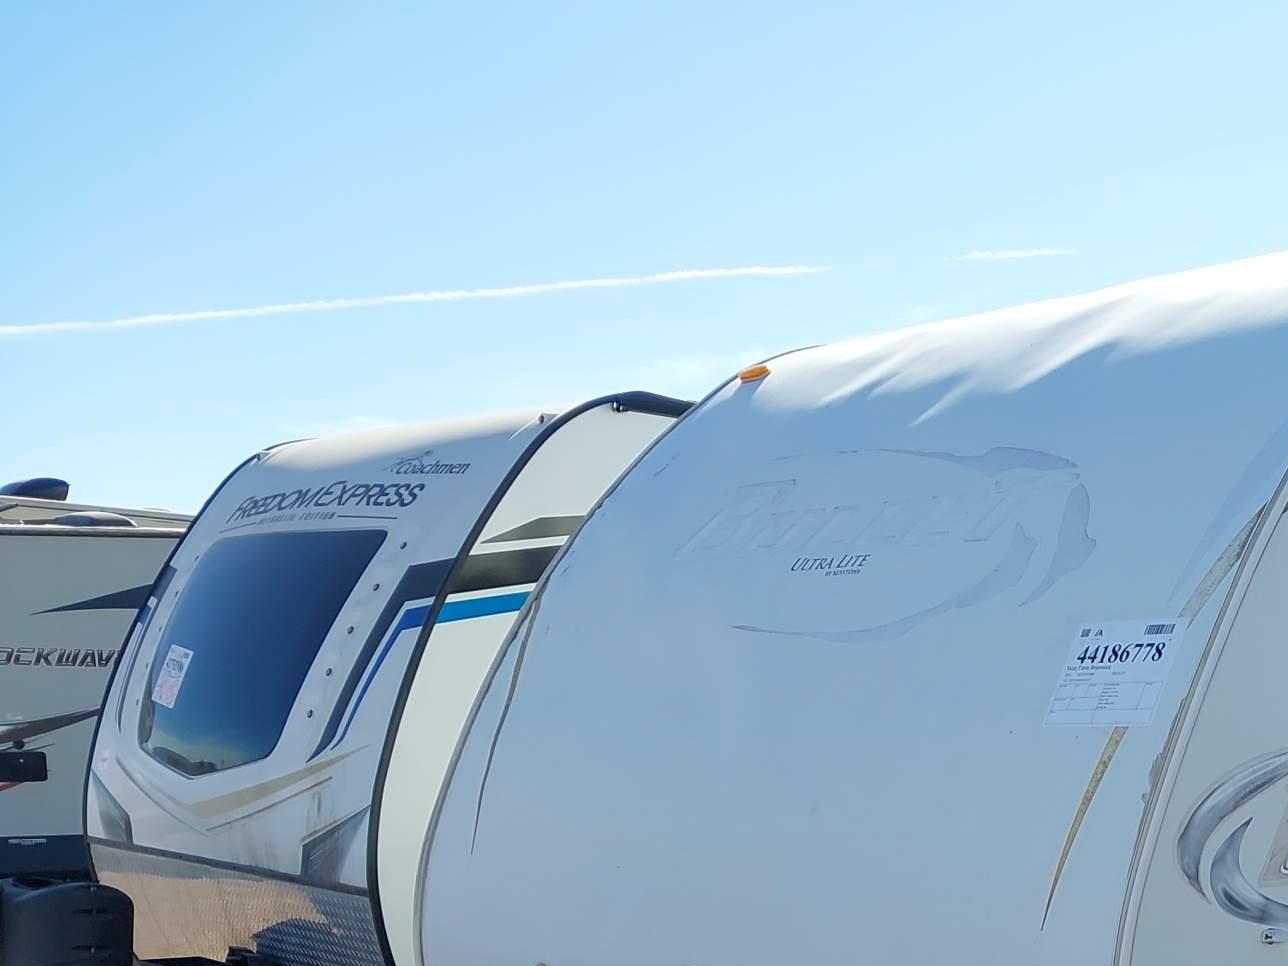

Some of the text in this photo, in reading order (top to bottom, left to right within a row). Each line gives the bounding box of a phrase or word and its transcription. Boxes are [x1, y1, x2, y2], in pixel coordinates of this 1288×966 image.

[394, 460, 471, 475] Coachmen
[790, 553, 871, 572] ULTRA LITE
[1077, 642, 1167, 664] 44186778
